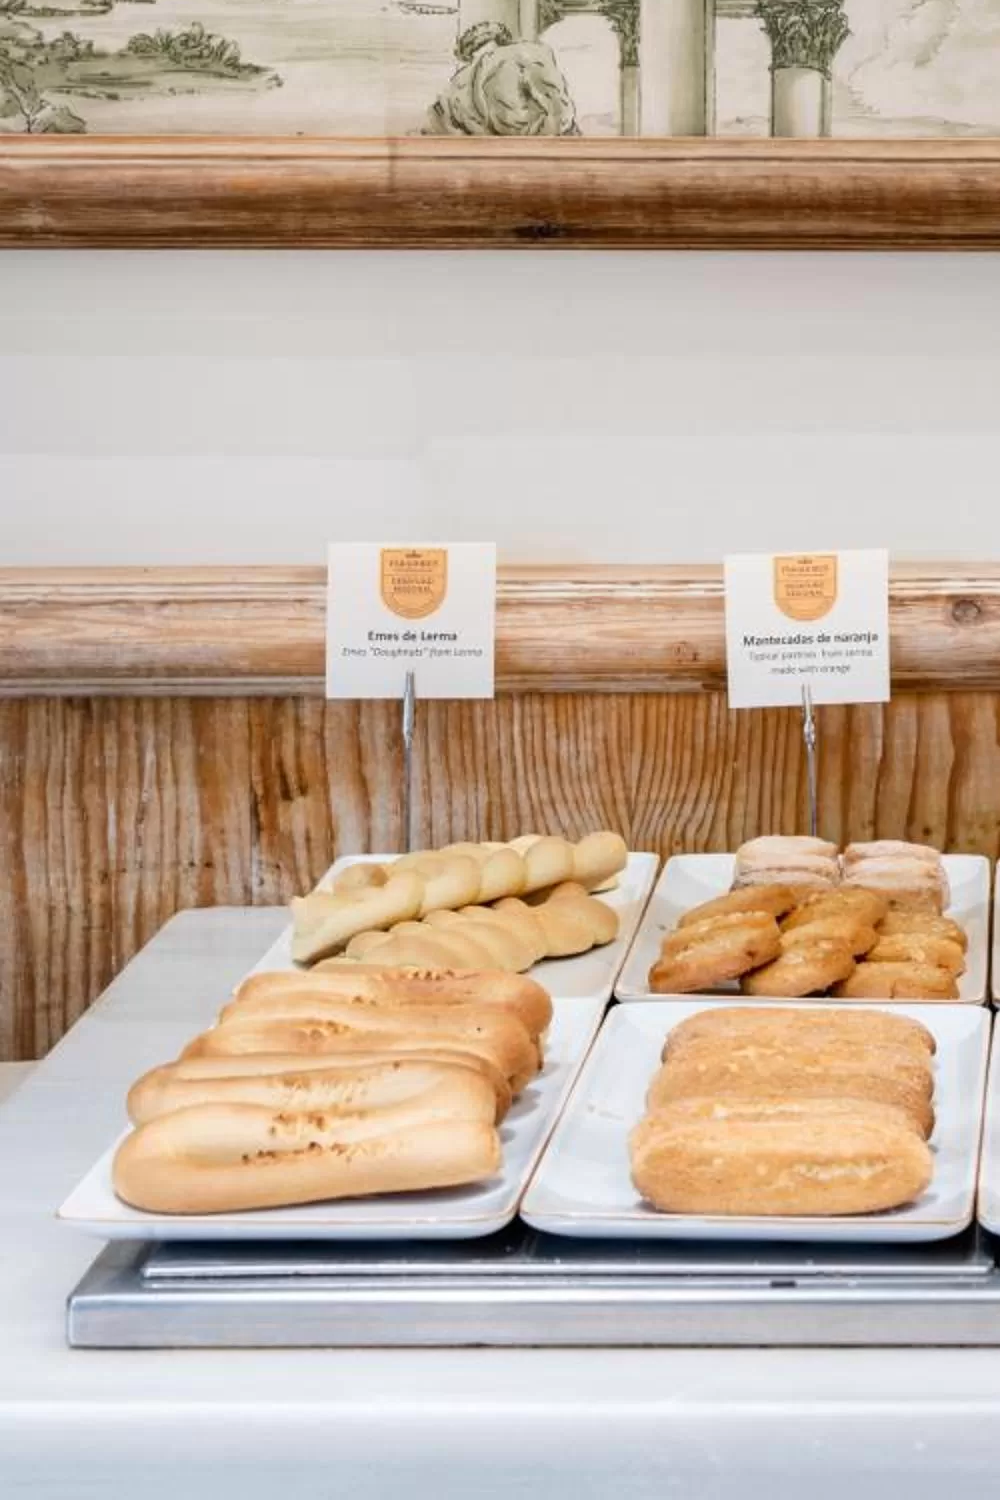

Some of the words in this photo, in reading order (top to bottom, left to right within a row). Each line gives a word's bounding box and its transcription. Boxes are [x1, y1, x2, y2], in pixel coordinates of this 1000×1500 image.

[367, 631, 399, 641] Emes
[402, 630, 417, 641] de
[421, 631, 458, 641] Lerma
[817, 633, 832, 643] de
